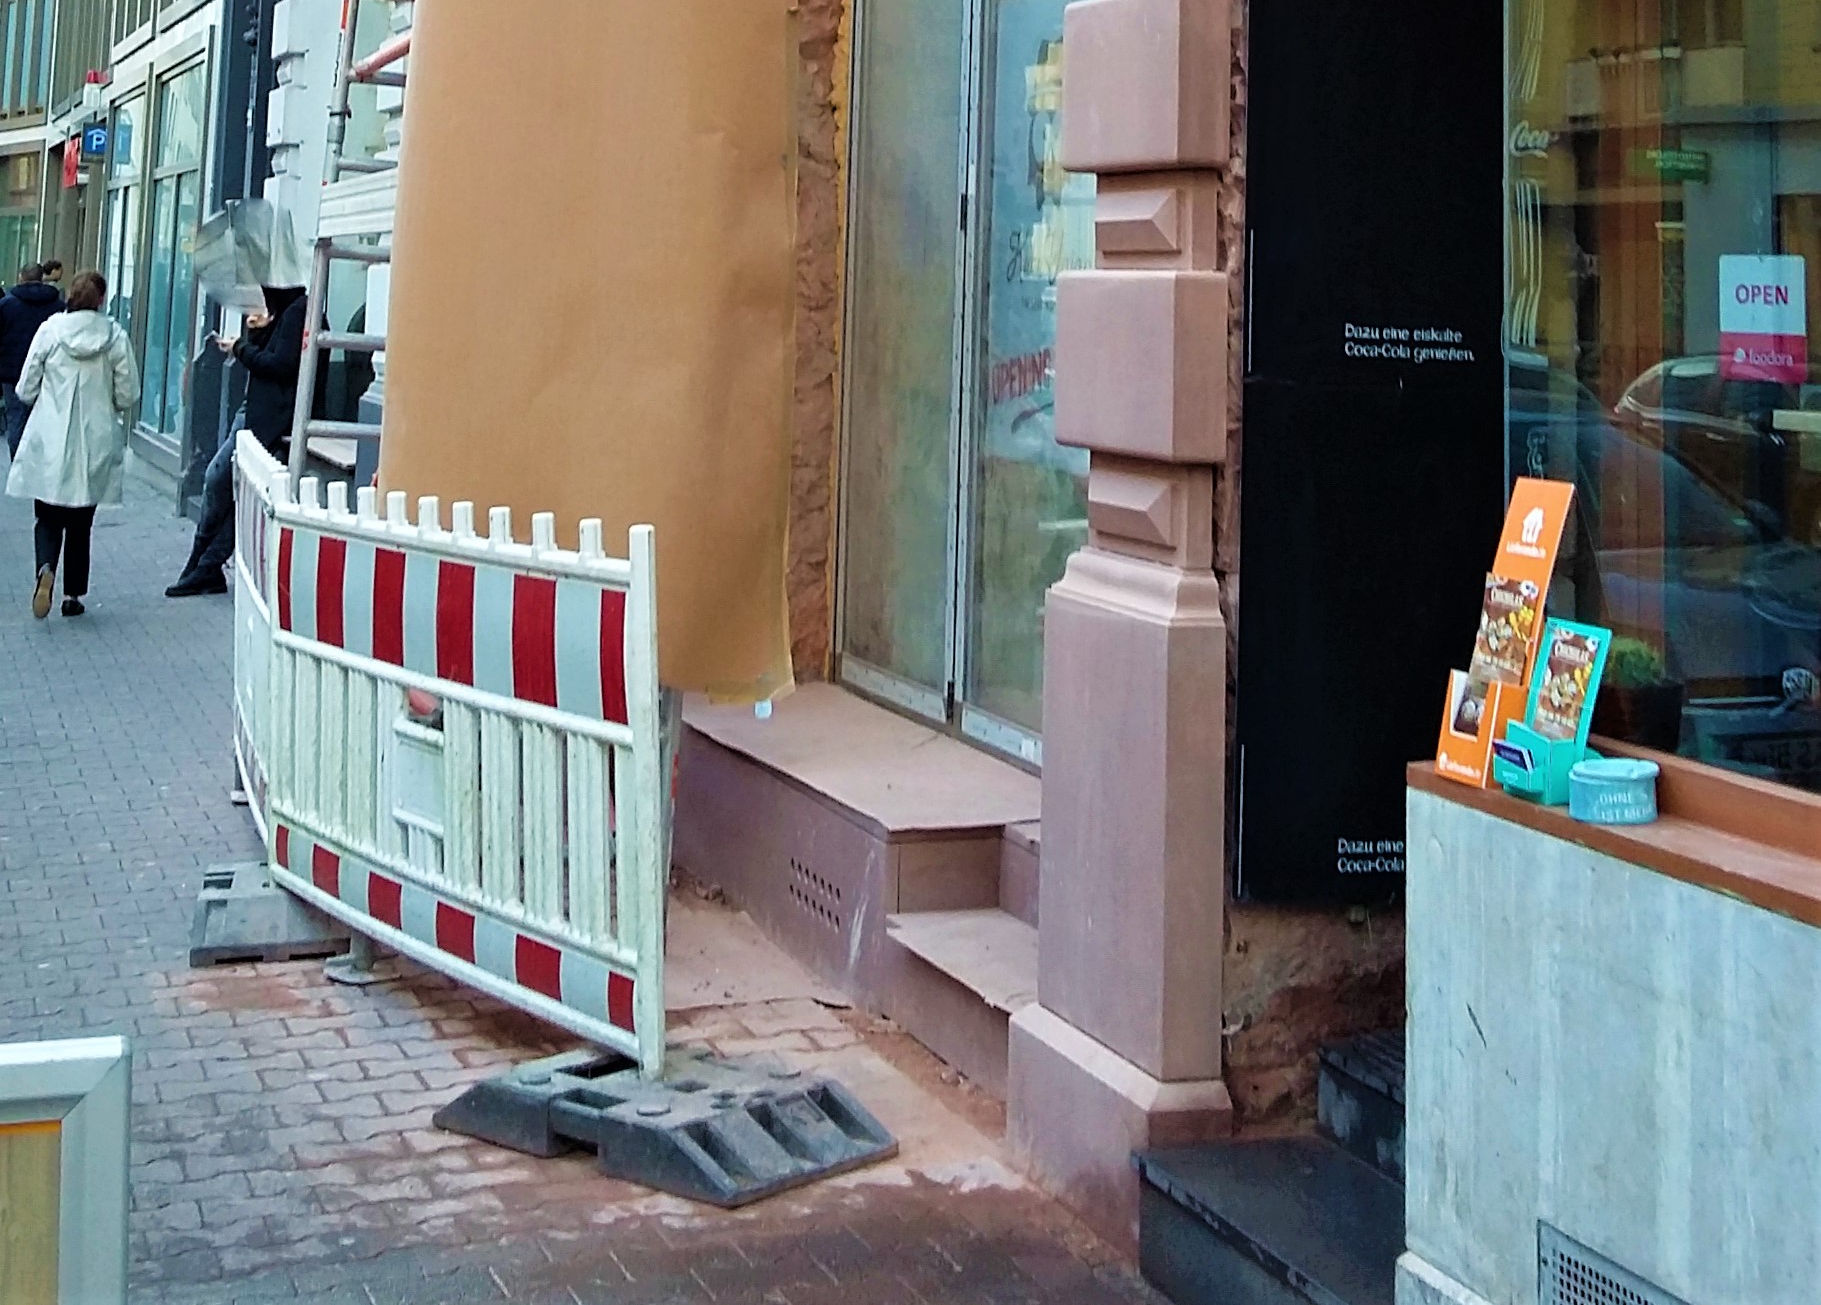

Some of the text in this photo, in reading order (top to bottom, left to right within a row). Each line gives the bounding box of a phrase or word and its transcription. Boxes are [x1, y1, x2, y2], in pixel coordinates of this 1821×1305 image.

[92, 134, 105, 150] P
[1735, 284, 1788, 305] OPEN
[1344, 322, 1463, 343] Dazu eine eiskalte
[1344, 341, 1410, 359] Coca-Cola
[1337, 837, 1404, 854] Dazu eine
[1337, 856, 1405, 873] Coca-Cola
